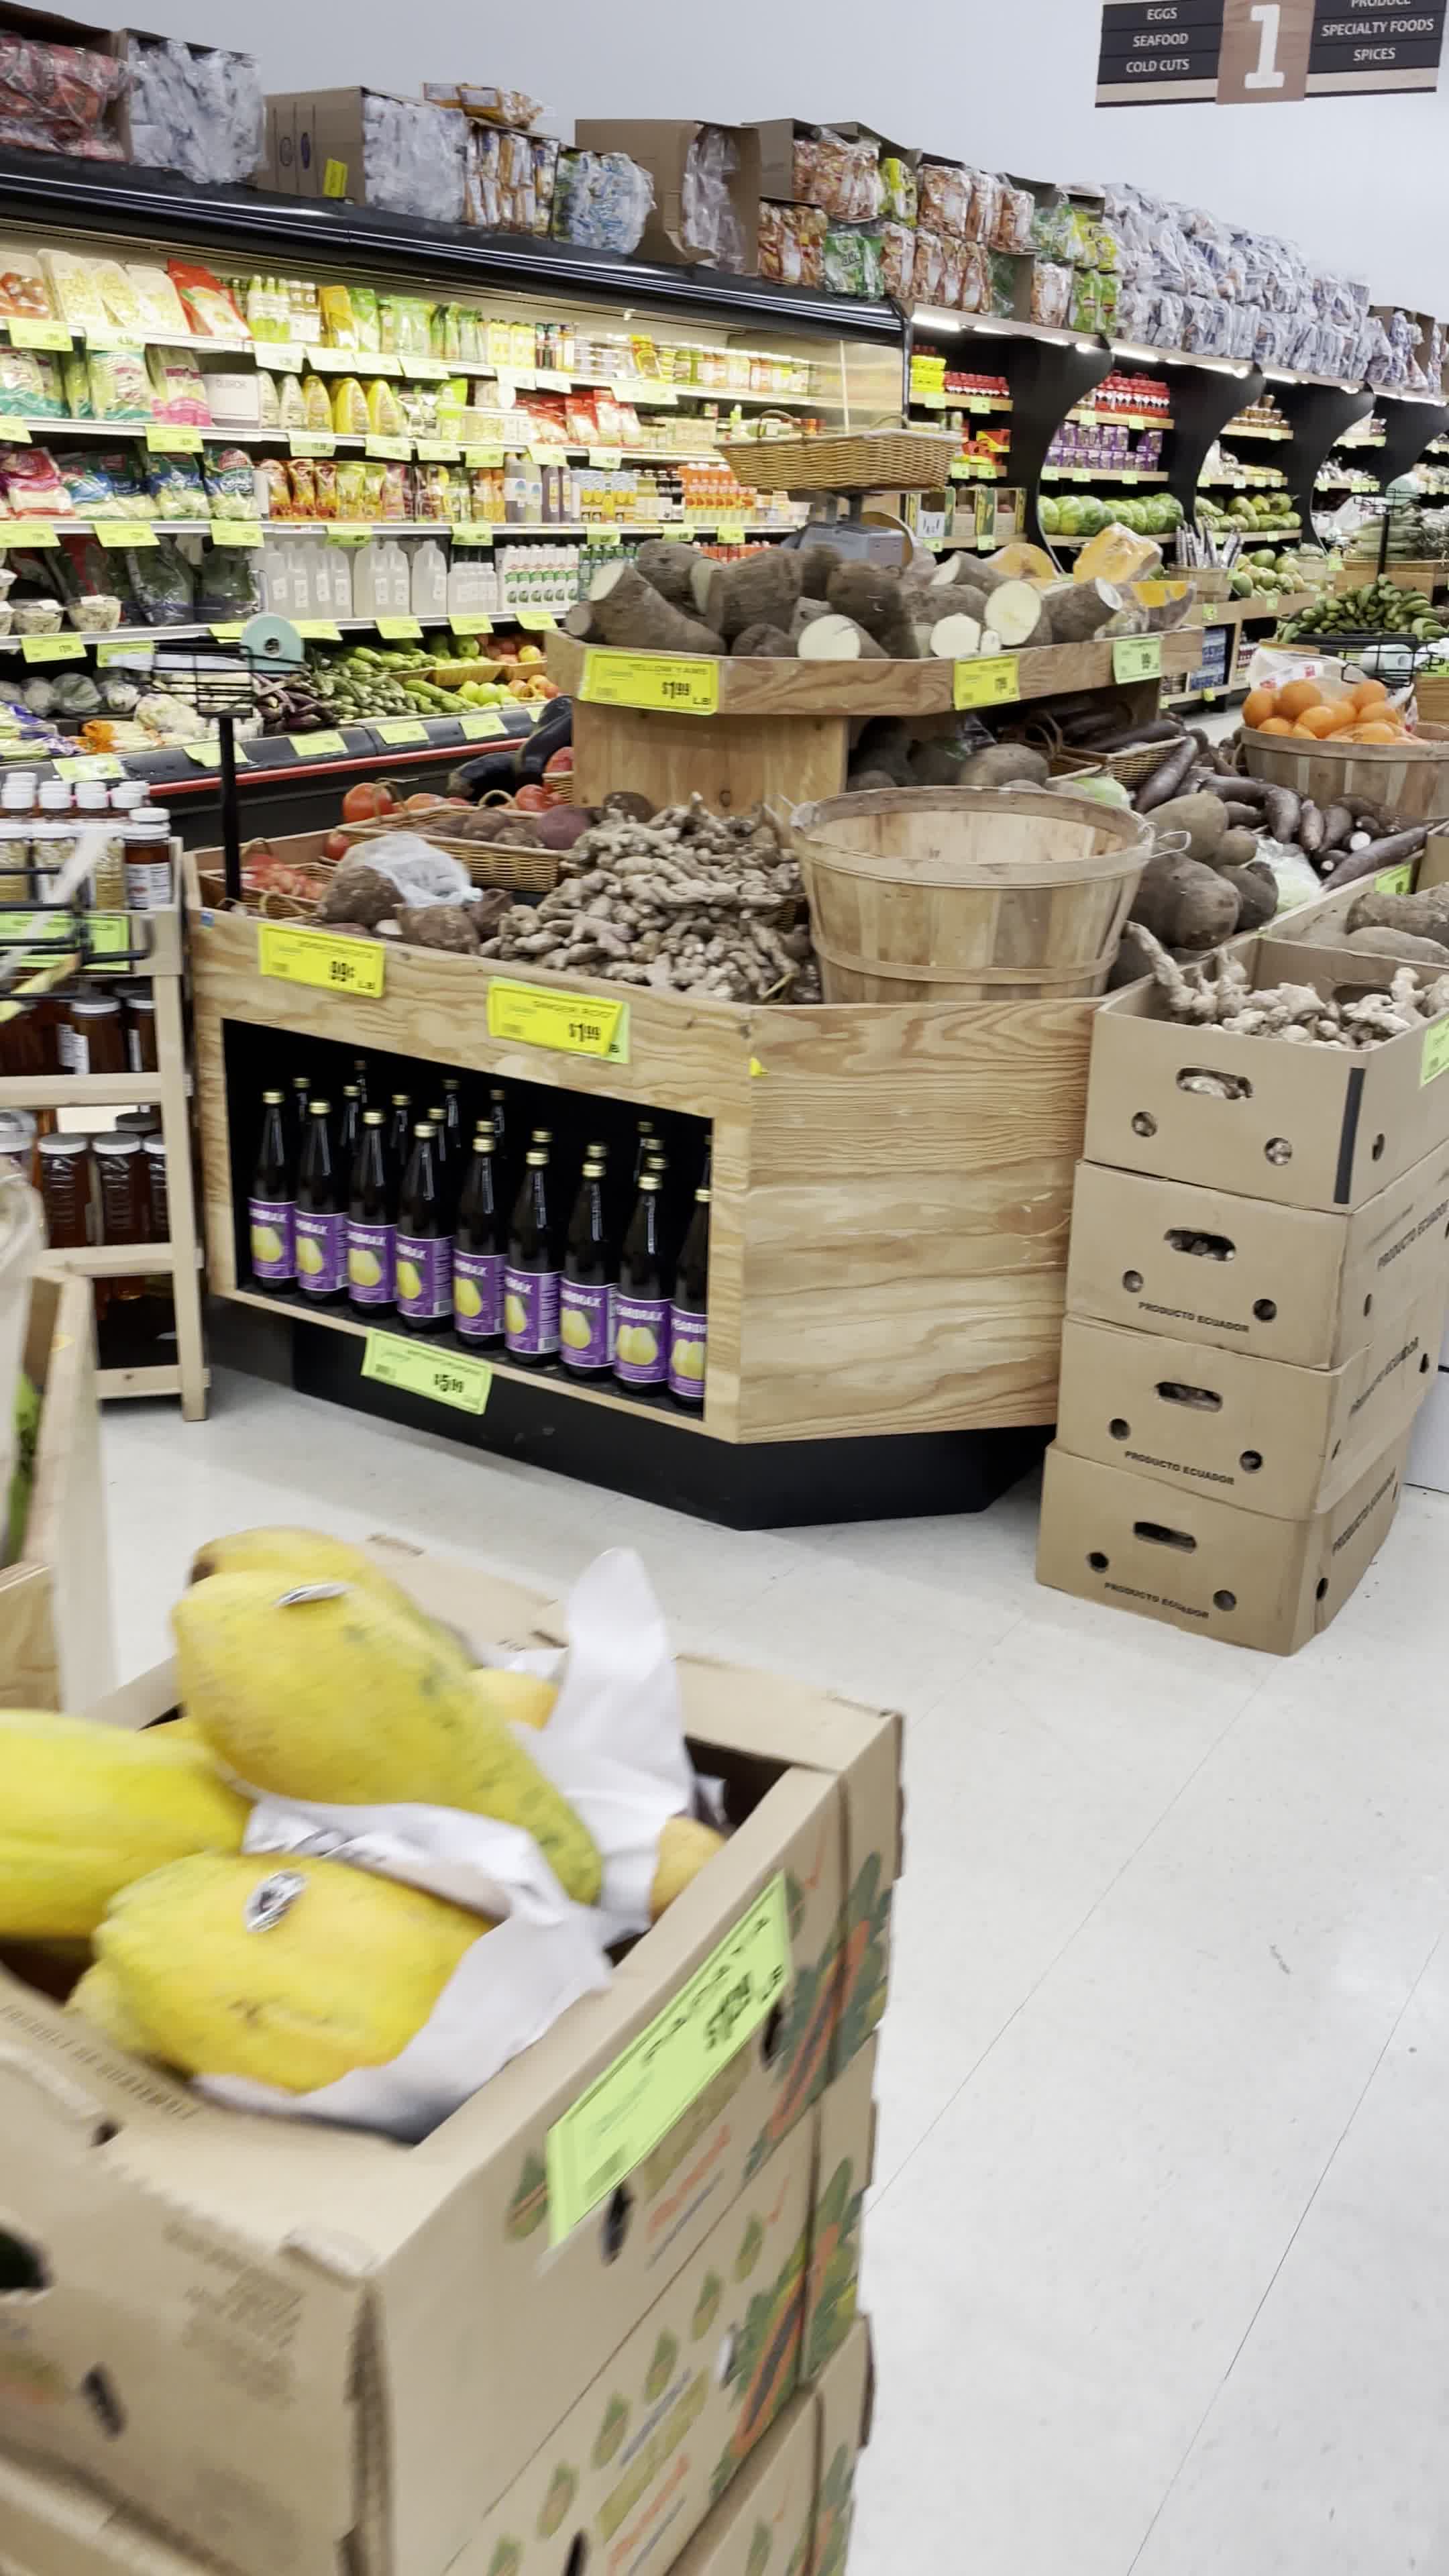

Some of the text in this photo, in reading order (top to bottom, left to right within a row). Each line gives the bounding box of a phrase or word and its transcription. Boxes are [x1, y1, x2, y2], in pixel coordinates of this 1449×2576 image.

[1146, 7, 1178, 20] EGGS
[1322, 18, 1434, 37] SPECIALTY FOODS
[1132, 33, 1189, 48] SEAFOOD
[1244, 4, 1285, 89] 1
[1353, 48, 1396, 62] SPICES
[1126, 58, 1190, 73] COLD CUTS
[1138, 1301, 1250, 1333] PRODUCTO ECUADOR
[1124, 1450, 1235, 1486] PRODUCTO ECUADOR
[1104, 1582, 1210, 1619] PRODUCTO ECUADOR
